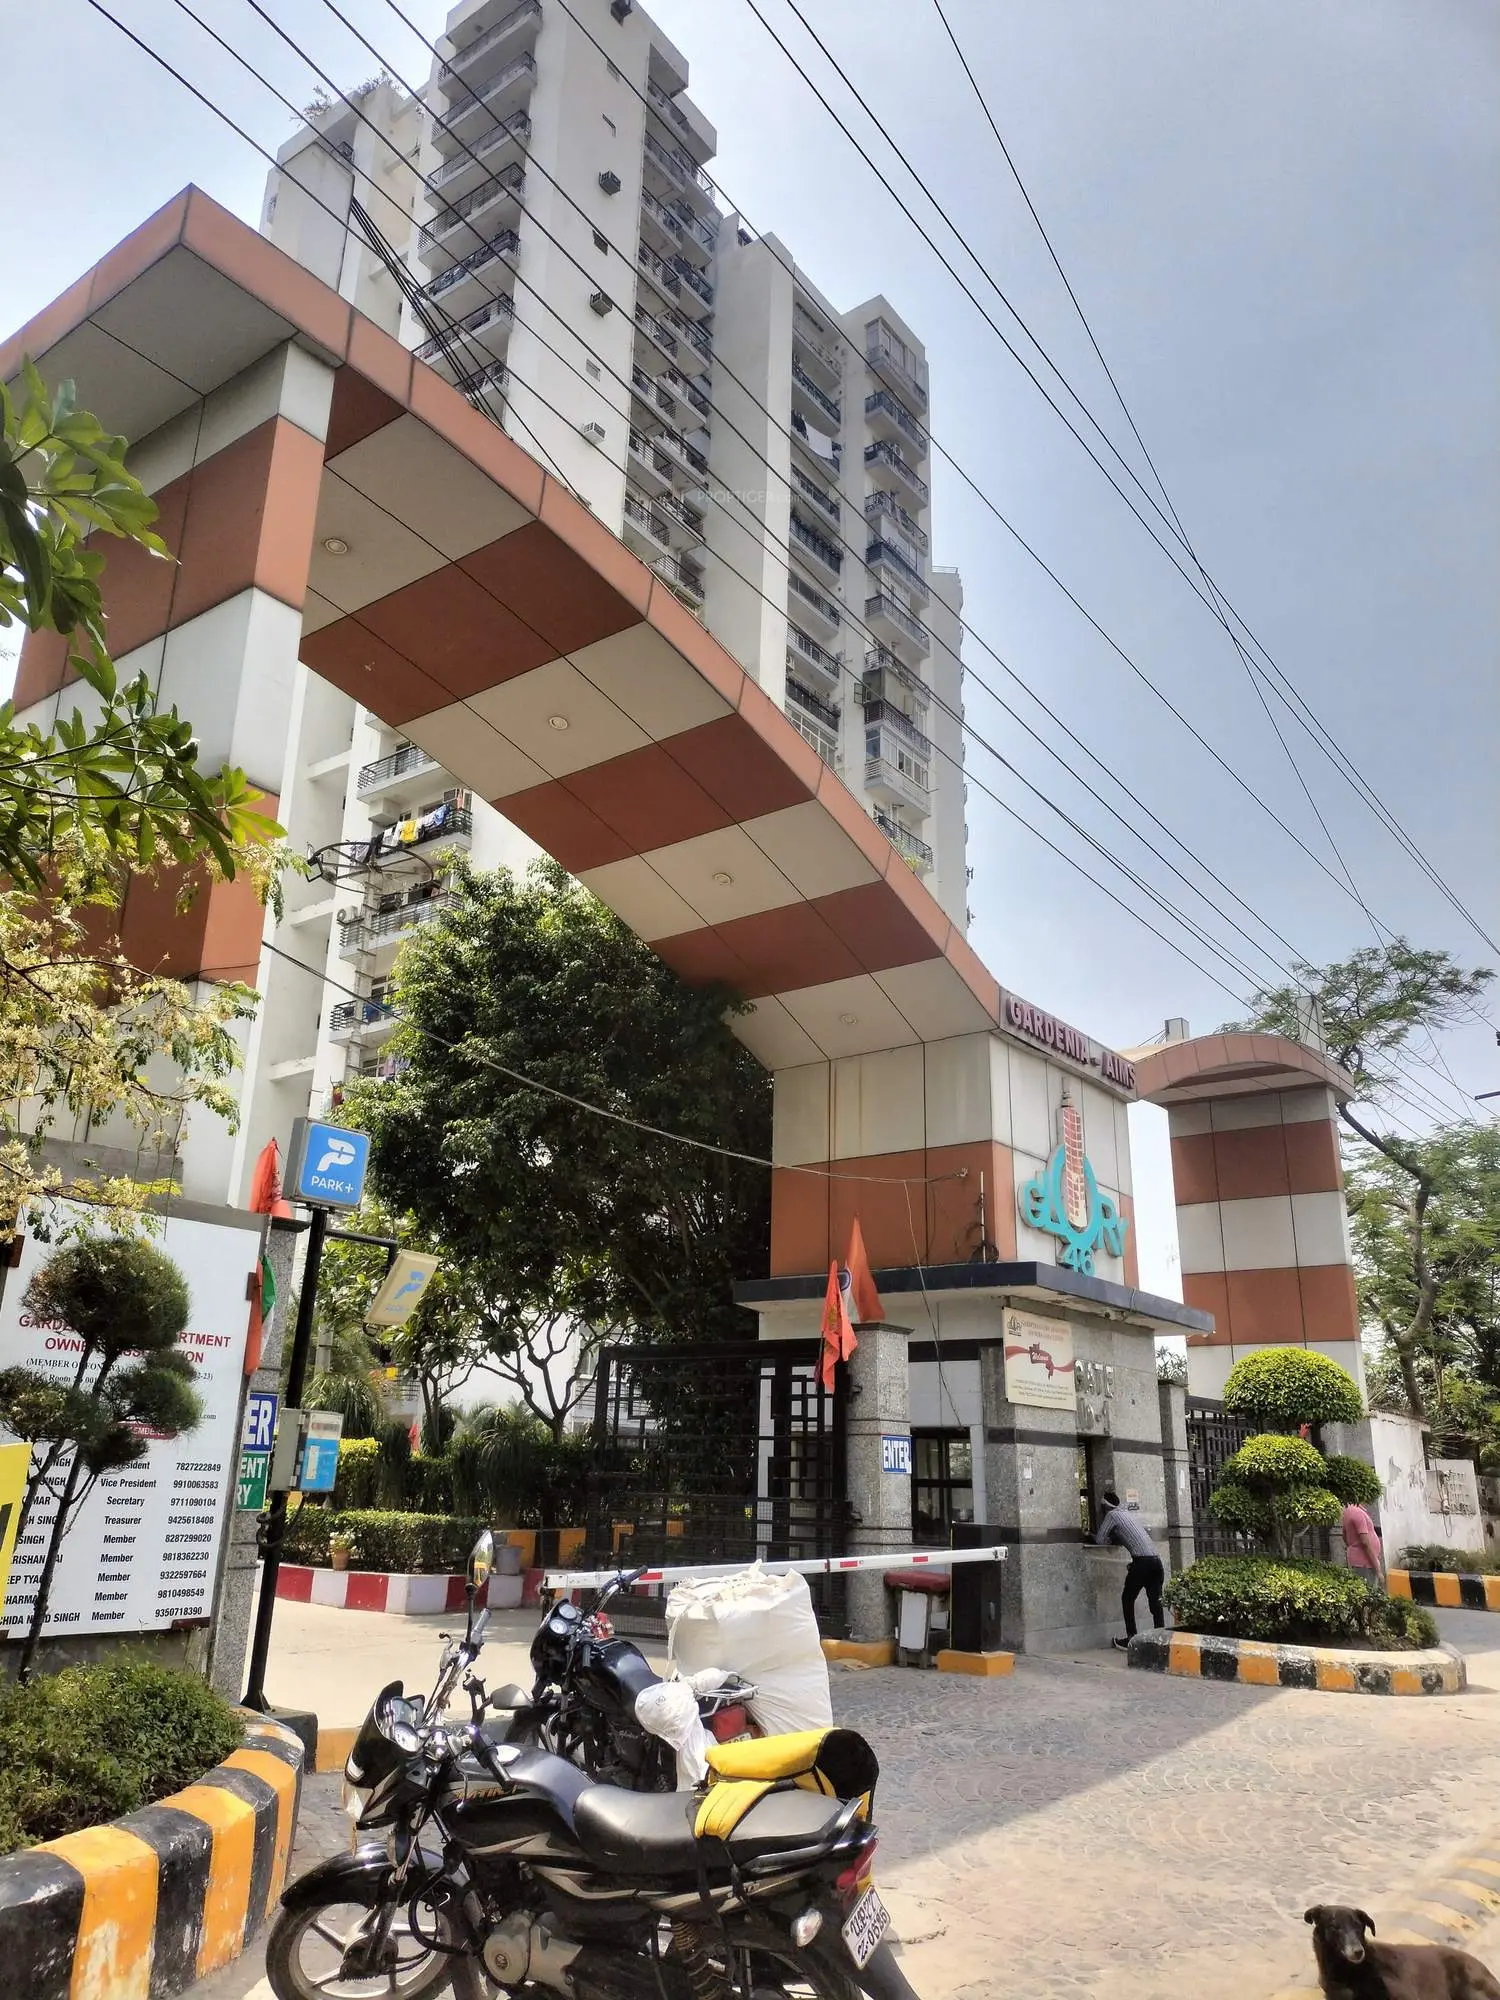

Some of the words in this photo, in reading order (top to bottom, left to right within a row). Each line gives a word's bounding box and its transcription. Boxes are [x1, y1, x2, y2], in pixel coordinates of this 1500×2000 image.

[1006, 996, 1088, 1065] GARDENIA
[1101, 1051, 1136, 1090] AIMS
[311, 1175, 354, 1193] PARK+
[1056, 1246, 1095, 1278] 46
[178, 1331, 231, 1348] RTMENT
[242, 1400, 272, 1446] ER
[882, 1439, 910, 1469] ENTER
[176, 1462, 221, 1472] 7827222849
[240, 1457, 265, 1478] ENT
[101, 1478, 118, 1488] Vice
[120, 1478, 156, 1488] President
[173, 1480, 219, 1489] 9910063583
[107, 1496, 145, 1507] Secretary
[170, 1498, 216, 1507] 9711090104
[104, 1516, 142, 1525] Treasurer
[168, 1516, 214, 1525] 9425618408
[18, 1536, 45, 1545] SINGH
[103, 1535, 136, 1544] Member
[165, 1534, 212, 1543] 8287299020
[11, 1555, 46, 1565] RISHAN
[100, 1554, 133, 1563] Member
[162, 1551, 209, 1561] 9818362230
[97, 1573, 130, 1582] Member
[160, 1570, 207, 1580] 9322597664
[94, 1592, 128, 1601] Member
[157, 1588, 205, 1598] 9810498549
[53, 1612, 80, 1622] SINGH
[91, 1611, 125, 1621] Member
[155, 1607, 203, 1618] 9350718390
